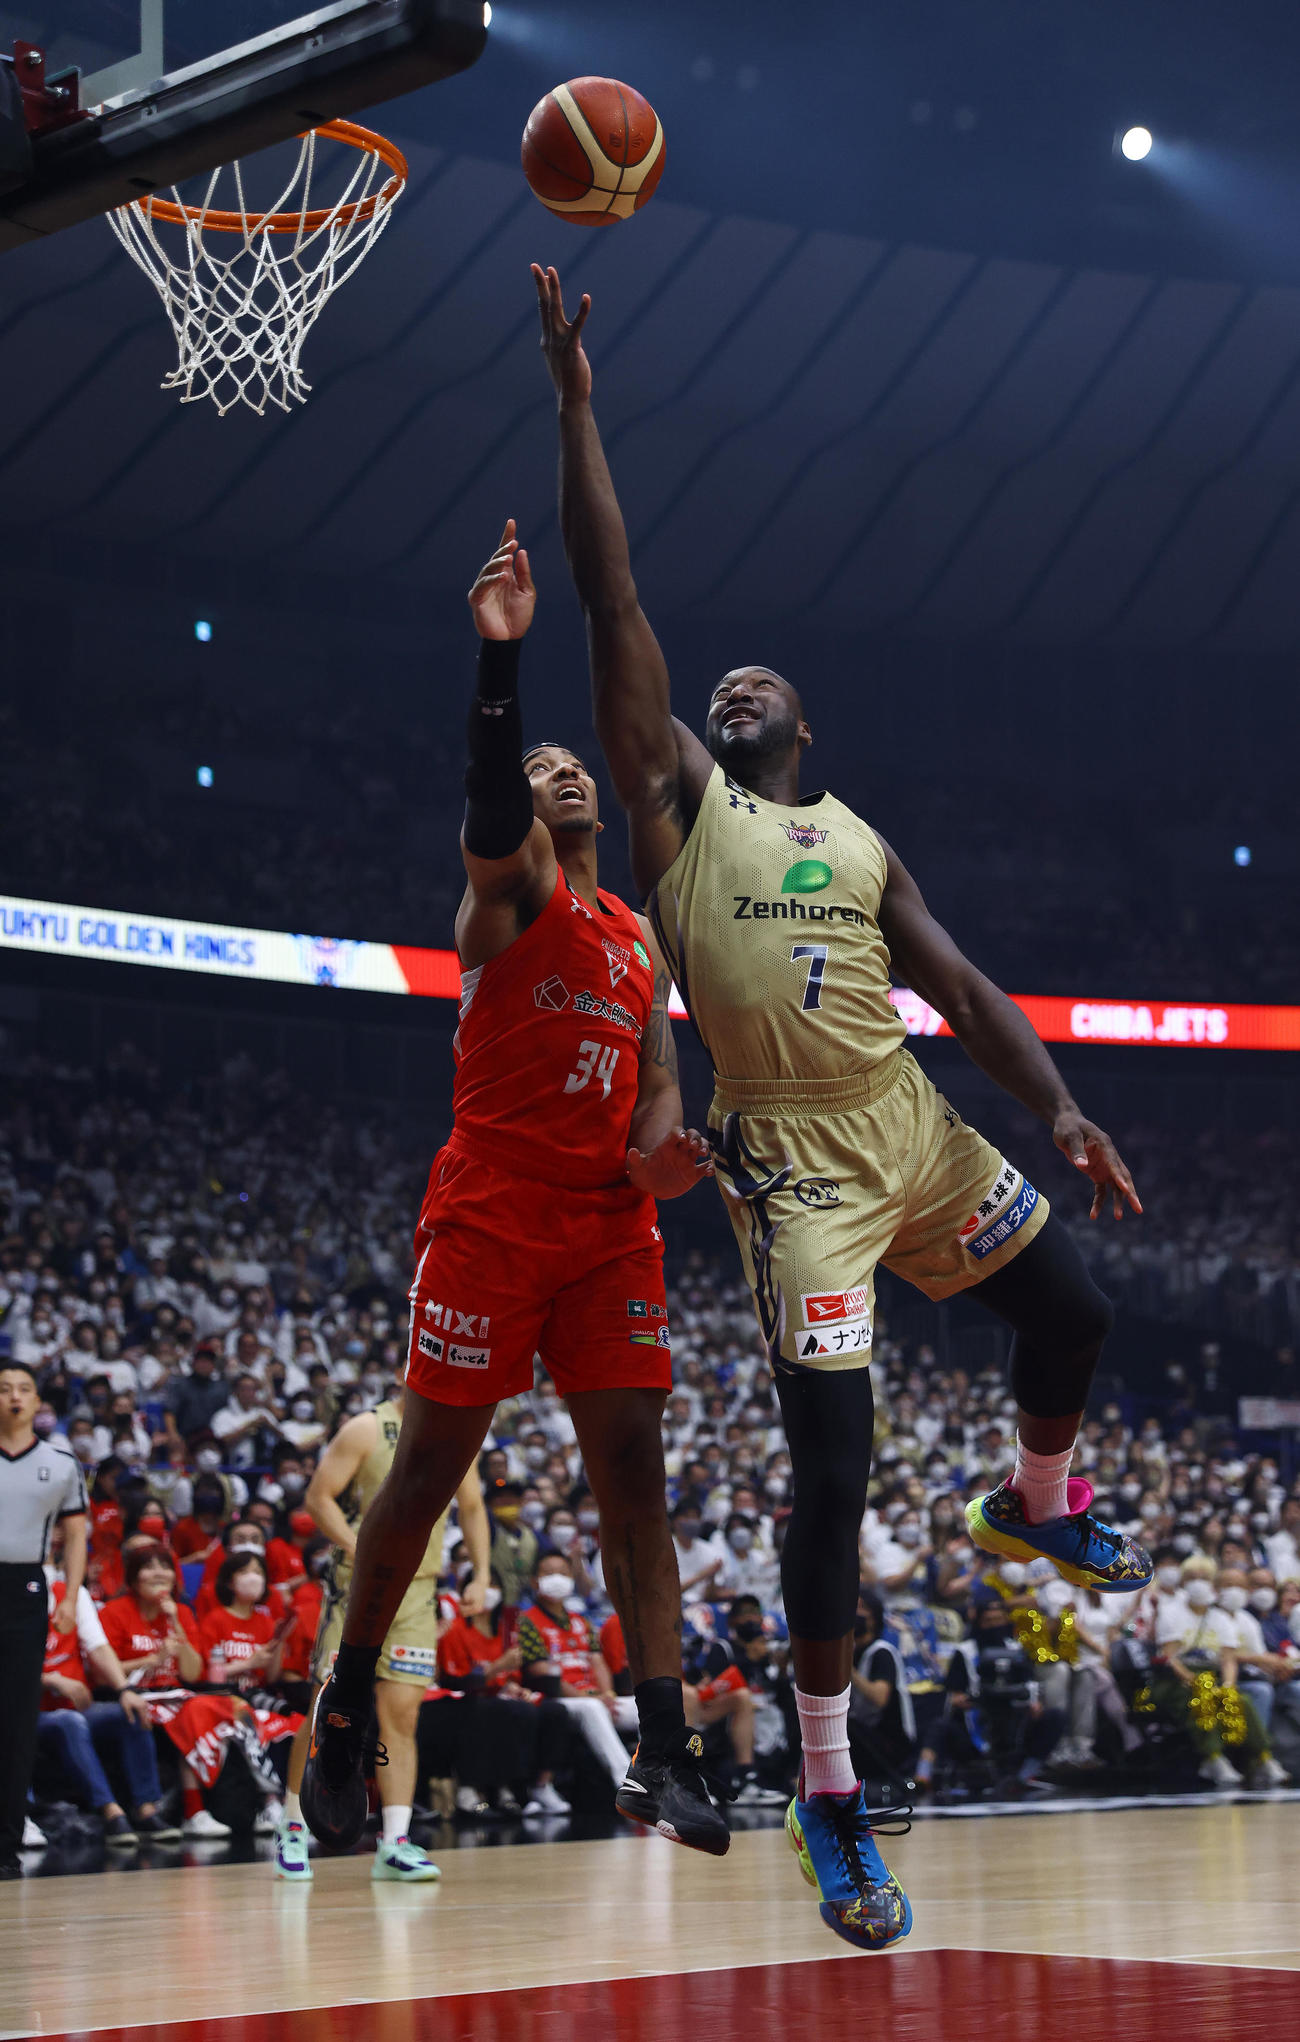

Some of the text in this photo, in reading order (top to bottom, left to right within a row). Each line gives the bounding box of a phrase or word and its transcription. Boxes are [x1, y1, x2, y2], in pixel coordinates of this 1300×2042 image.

[733, 896, 865, 927] Zenhoren
[79, 917, 175, 957] GOLDEN
[790, 945, 828, 1011] 7
[1070, 1003, 1228, 1043] CHIBA JETS
[563, 1039, 620, 1102] 34
[977, 1163, 1018, 1218] 琉球銀
[974, 1182, 1038, 1253] 沖縄タイム
[425, 1298, 490, 1339] MIXI
